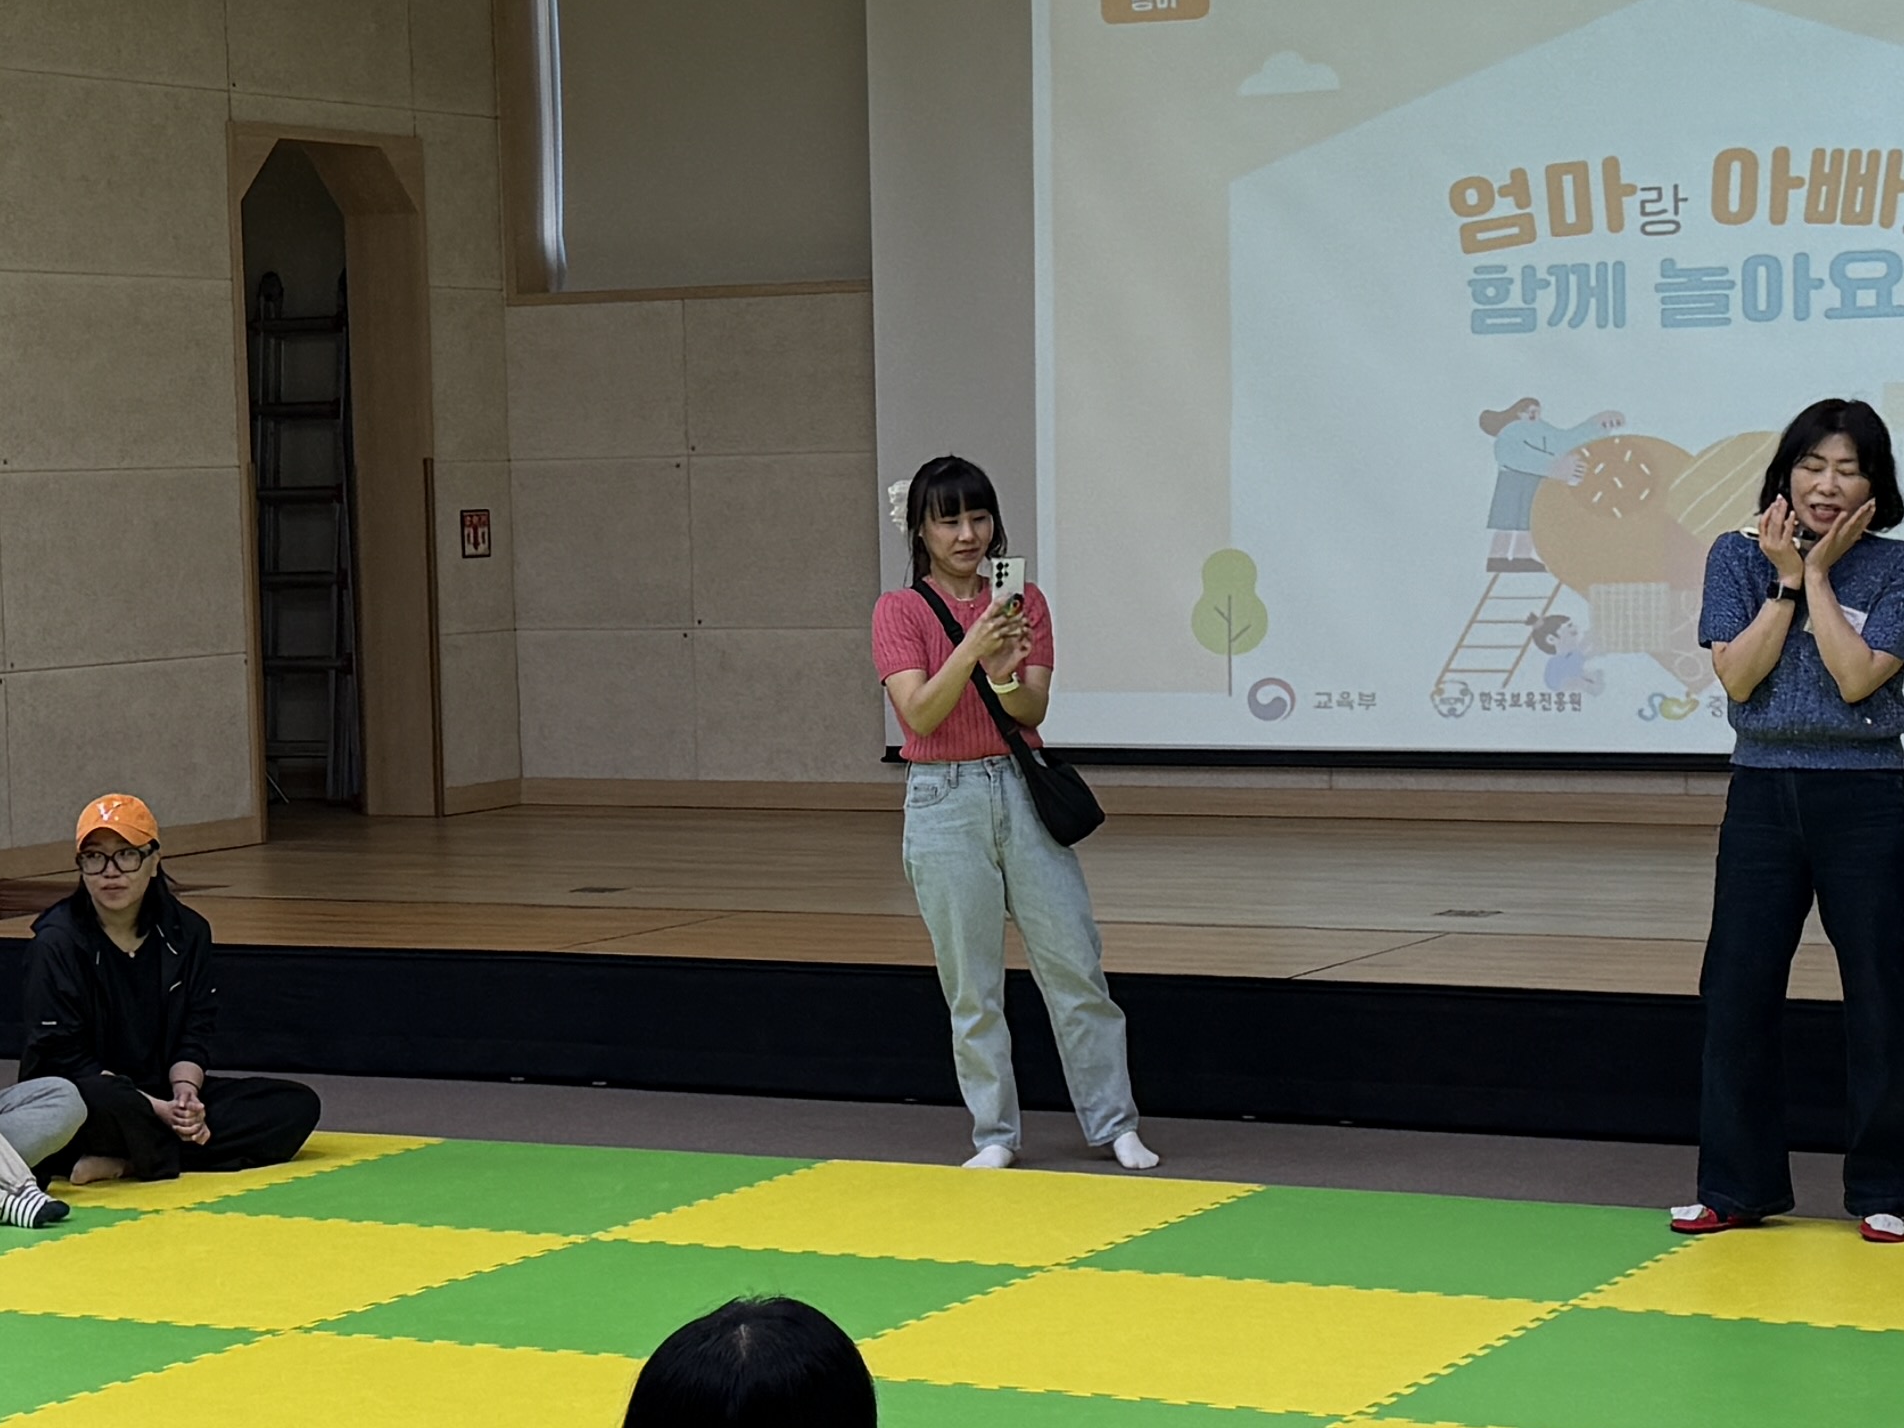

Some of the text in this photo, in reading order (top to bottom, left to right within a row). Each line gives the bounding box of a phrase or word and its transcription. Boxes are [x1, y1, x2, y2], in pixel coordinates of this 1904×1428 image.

[1448, 154, 1689, 255] 엄마랑
[1466, 259, 1627, 335] 함께
[1313, 690, 1377, 711] 교육부
